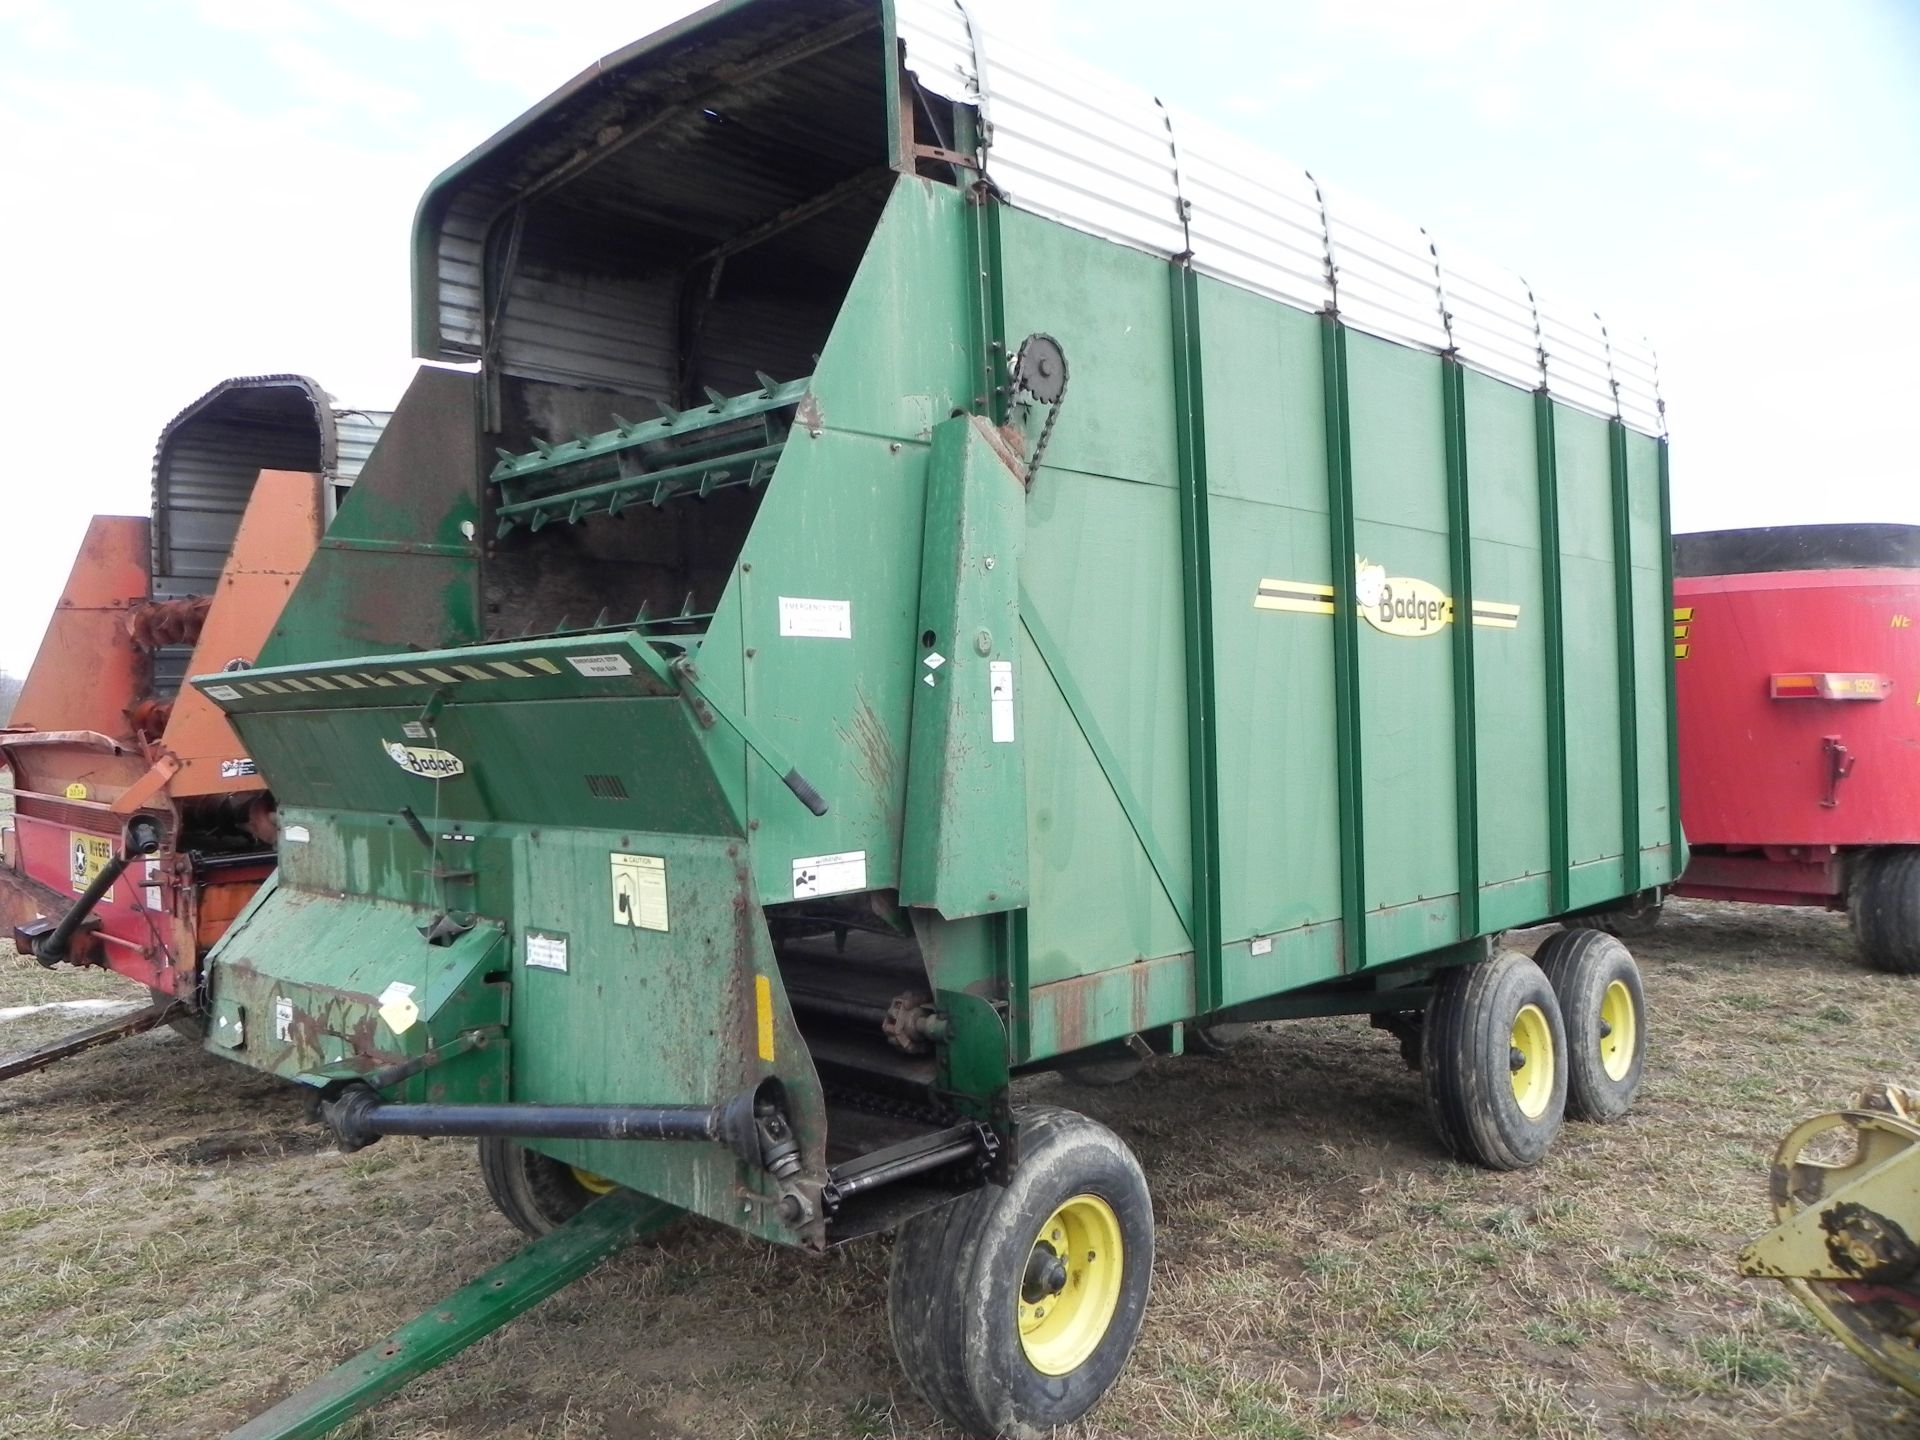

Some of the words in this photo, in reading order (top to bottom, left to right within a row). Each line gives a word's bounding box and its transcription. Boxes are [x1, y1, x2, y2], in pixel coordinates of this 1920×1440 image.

[1379, 584, 1445, 630] Badger
[407, 751, 459, 774] Badger
[628, 856, 652, 865] CAUTION
